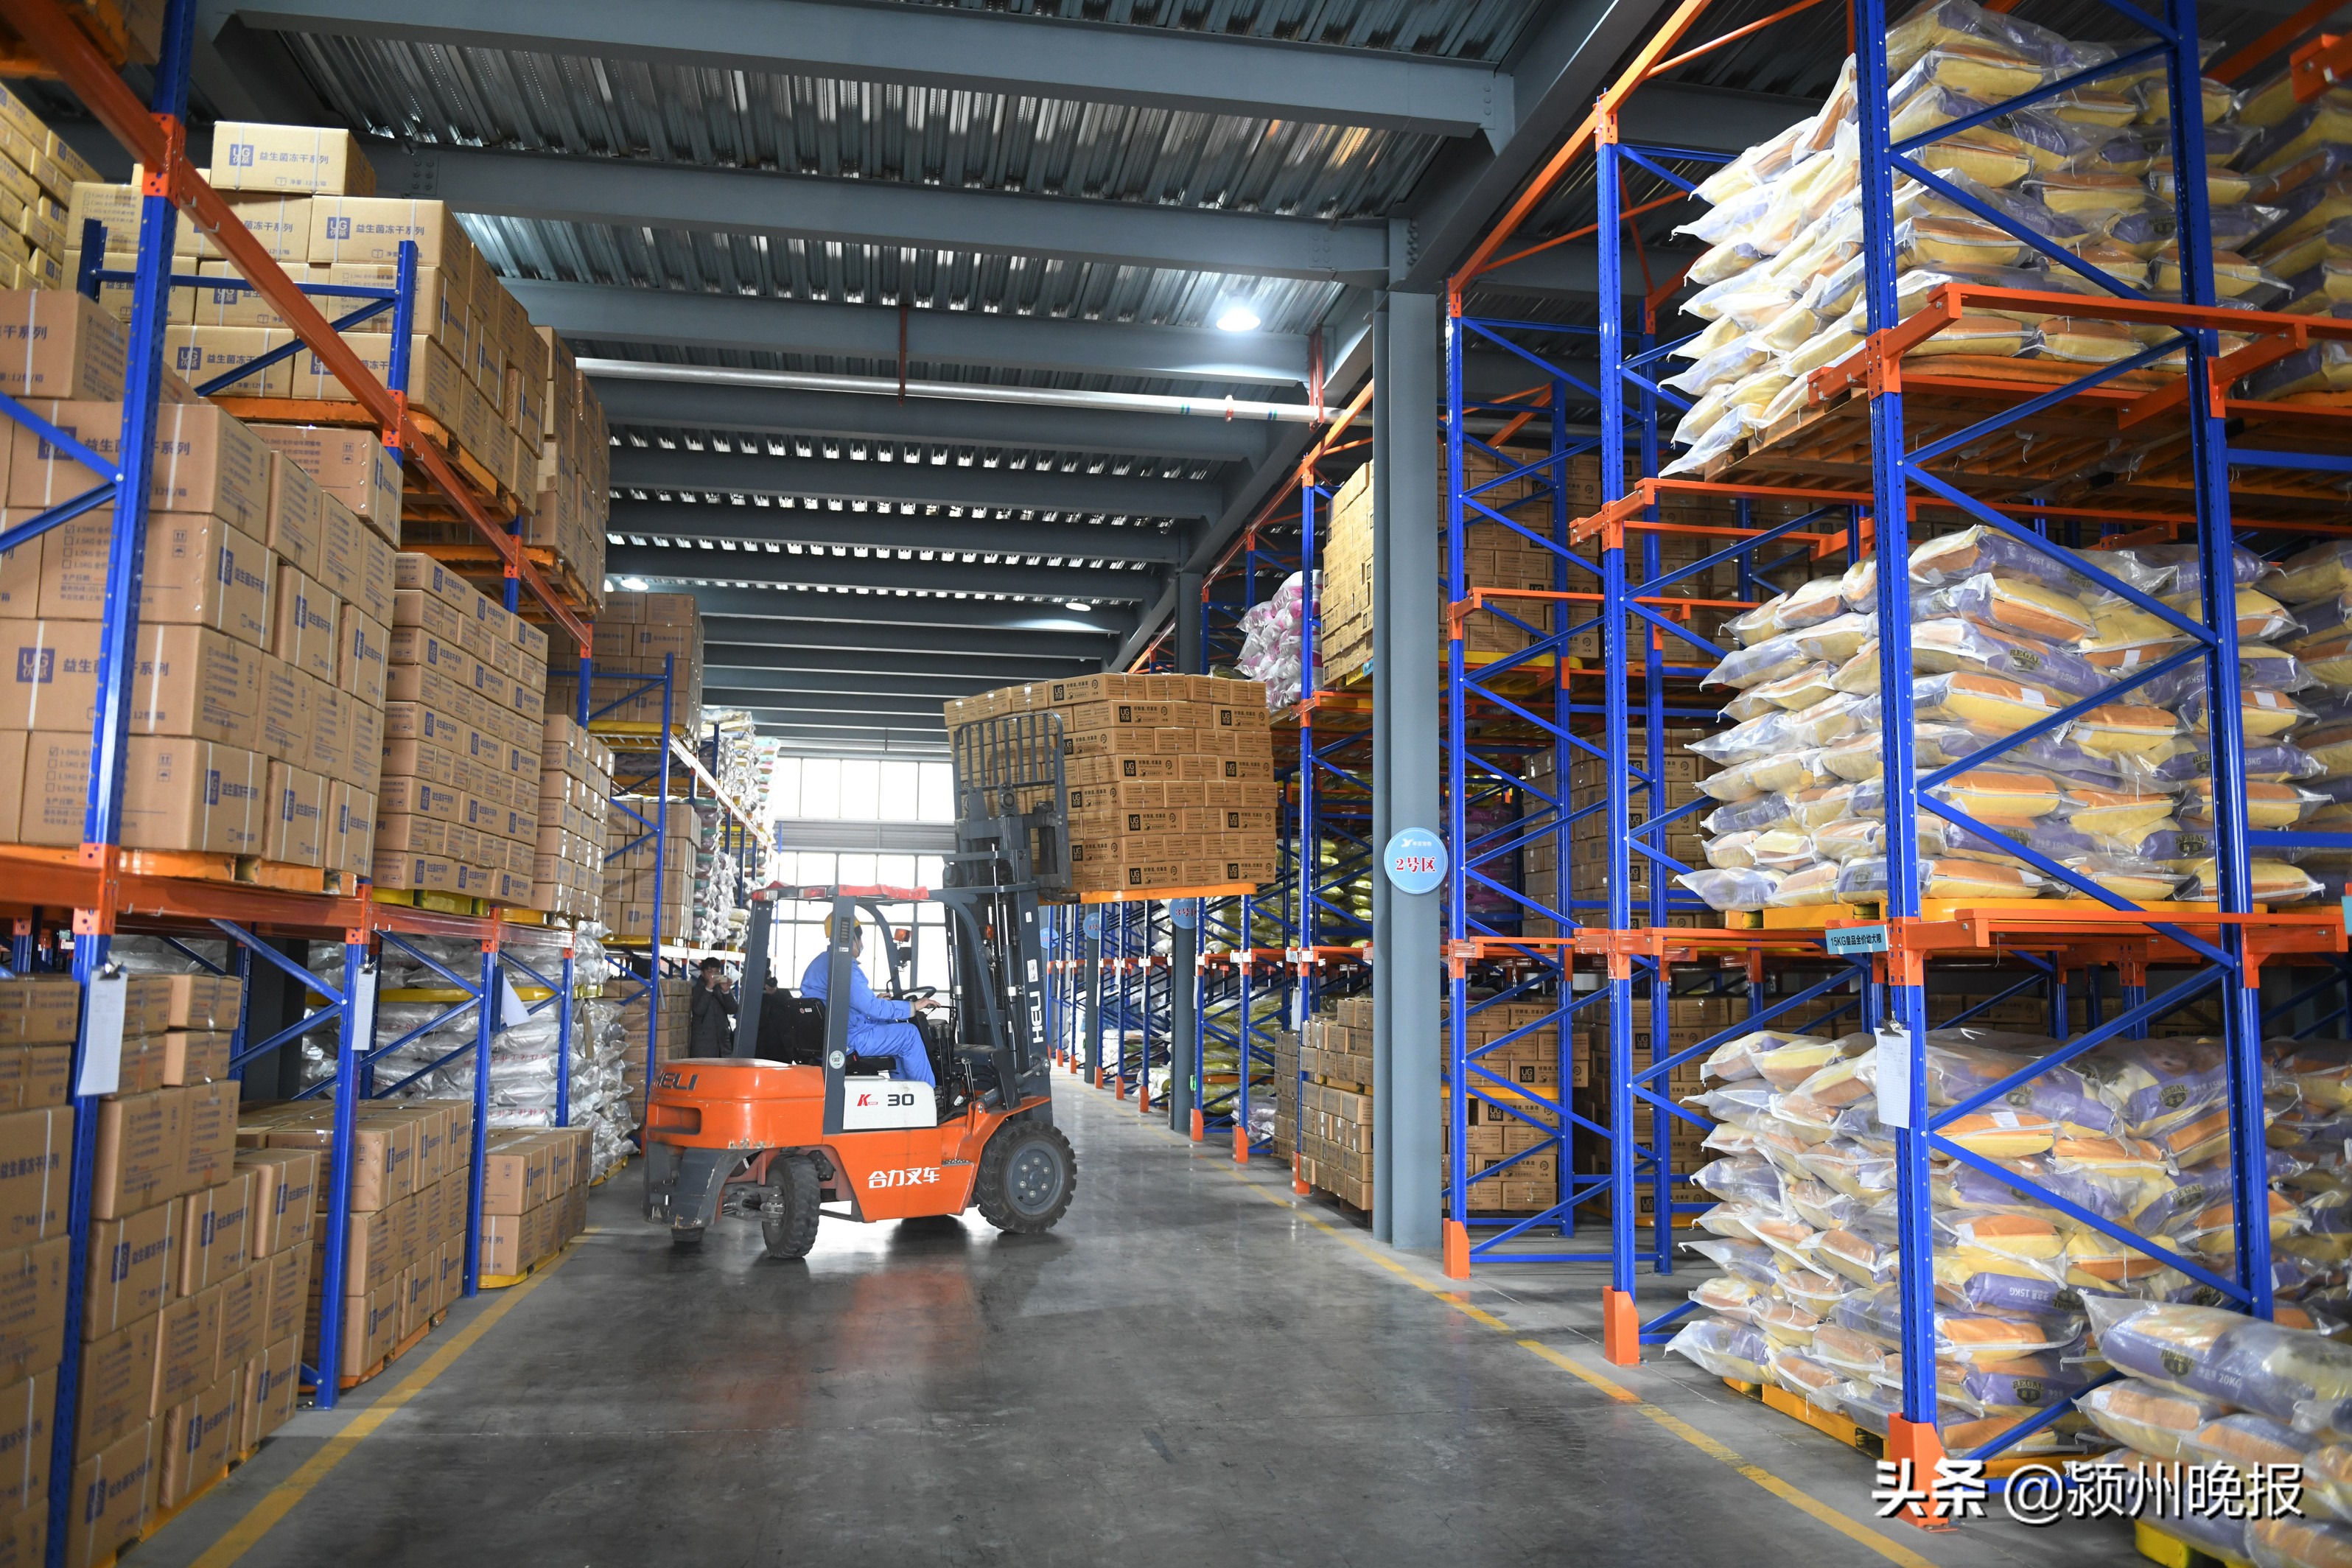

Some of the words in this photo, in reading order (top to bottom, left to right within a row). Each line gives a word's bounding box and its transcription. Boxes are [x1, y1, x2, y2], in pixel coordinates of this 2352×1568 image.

[233, 147, 251, 156] UG
[259, 152, 329, 164] 益生菌冻干系列
[329, 220, 347, 230] UG
[356, 224, 424, 236] 益生菌冻干系列
[181, 349, 197, 360] UG
[2026, 553, 2047, 567] 15KG
[23, 653, 49, 668] UG
[2009, 648, 2040, 664] REGAL
[1222, 712, 1231, 720] UG
[2244, 756, 2261, 766] 15KG
[2174, 832, 2207, 845] REGAL
[1396, 856, 1436, 873] 2号区
[1831, 934, 1882, 946] 15KG皇品全价幼犬粮
[1029, 991, 1043, 1043] HELI
[887, 1093, 914, 1106] 30
[1490, 1107, 1502, 1115] UG
[868, 1167, 940, 1189] 合力叉车
[2171, 1183, 2205, 1203] REGAL
[2009, 1287, 2030, 1297] 15KG
[2013, 1379, 2045, 1392] REGAL
[2218, 1373, 2243, 1388] 20KG
